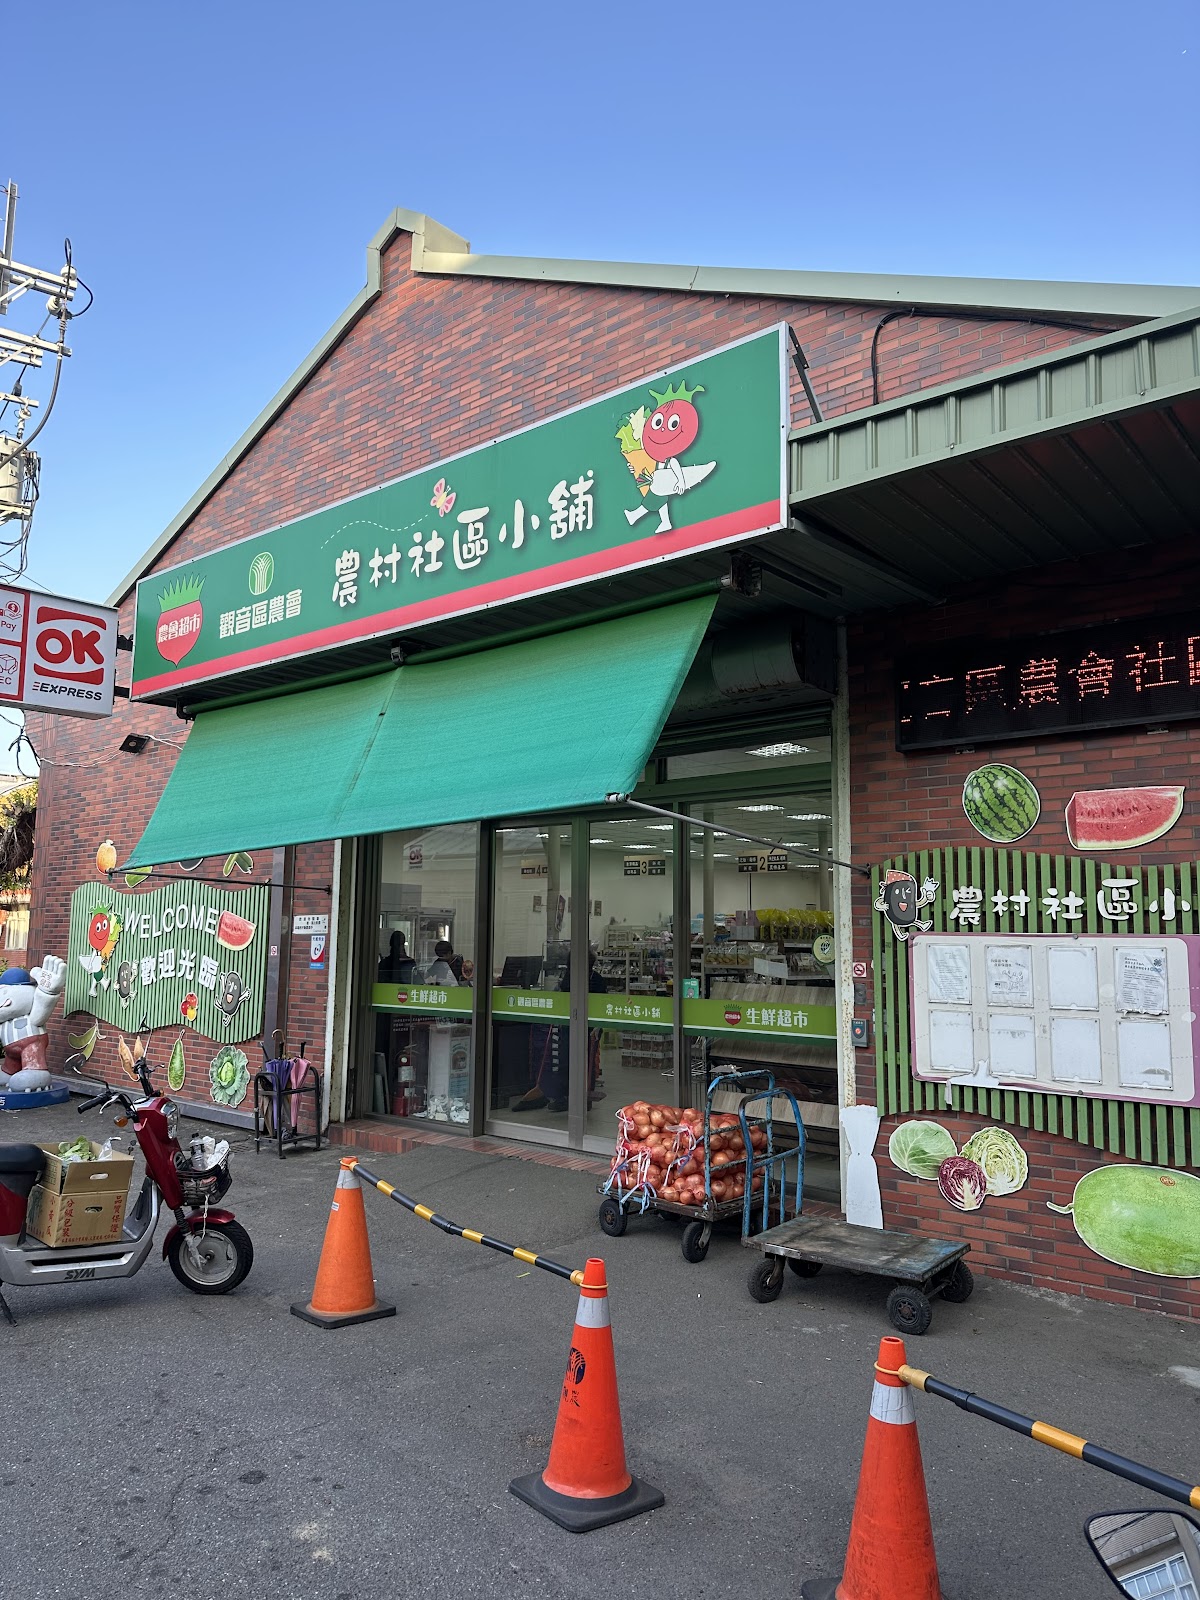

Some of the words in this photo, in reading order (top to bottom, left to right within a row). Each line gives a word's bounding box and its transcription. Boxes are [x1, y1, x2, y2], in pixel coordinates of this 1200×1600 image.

[332, 469, 594, 607] 農村社區小舖
[1, 620, 17, 632] Pay
[158, 613, 200, 643] 農會超市
[219, 589, 302, 639] 觀音區農會
[36, 628, 105, 665] OK
[39, 683, 103, 701] EXPRESS
[641, 861, 648, 874] 3
[760, 856, 766, 871] 2
[949, 878, 1191, 926] 農村社區小
[124, 904, 219, 939] WELCOME
[141, 948, 219, 991] 歡迎光臨
[410, 988, 448, 1005] 生鮮超市
[745, 1007, 809, 1029] 生鮮超市
[62, 1199, 75, 1238] 分級包裝
[64, 1268, 96, 1280] SYM
